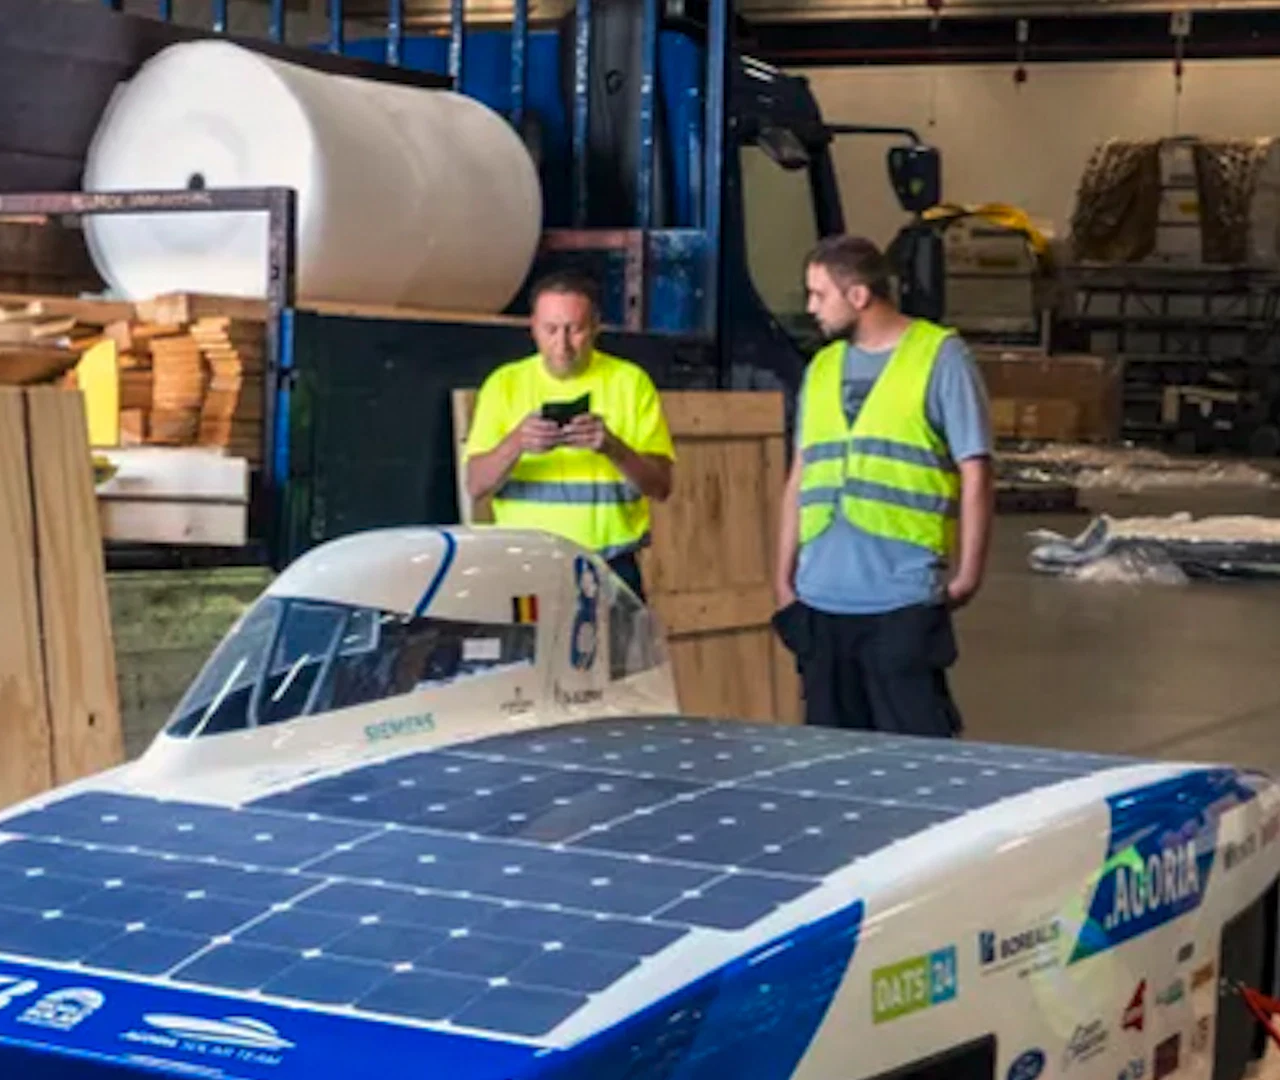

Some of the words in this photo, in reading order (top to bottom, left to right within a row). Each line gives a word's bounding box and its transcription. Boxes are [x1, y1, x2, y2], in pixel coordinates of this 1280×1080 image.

[364, 711, 436, 742] SIEMENS
[874, 967, 926, 1013] DATS
[932, 955, 955, 994] 24
